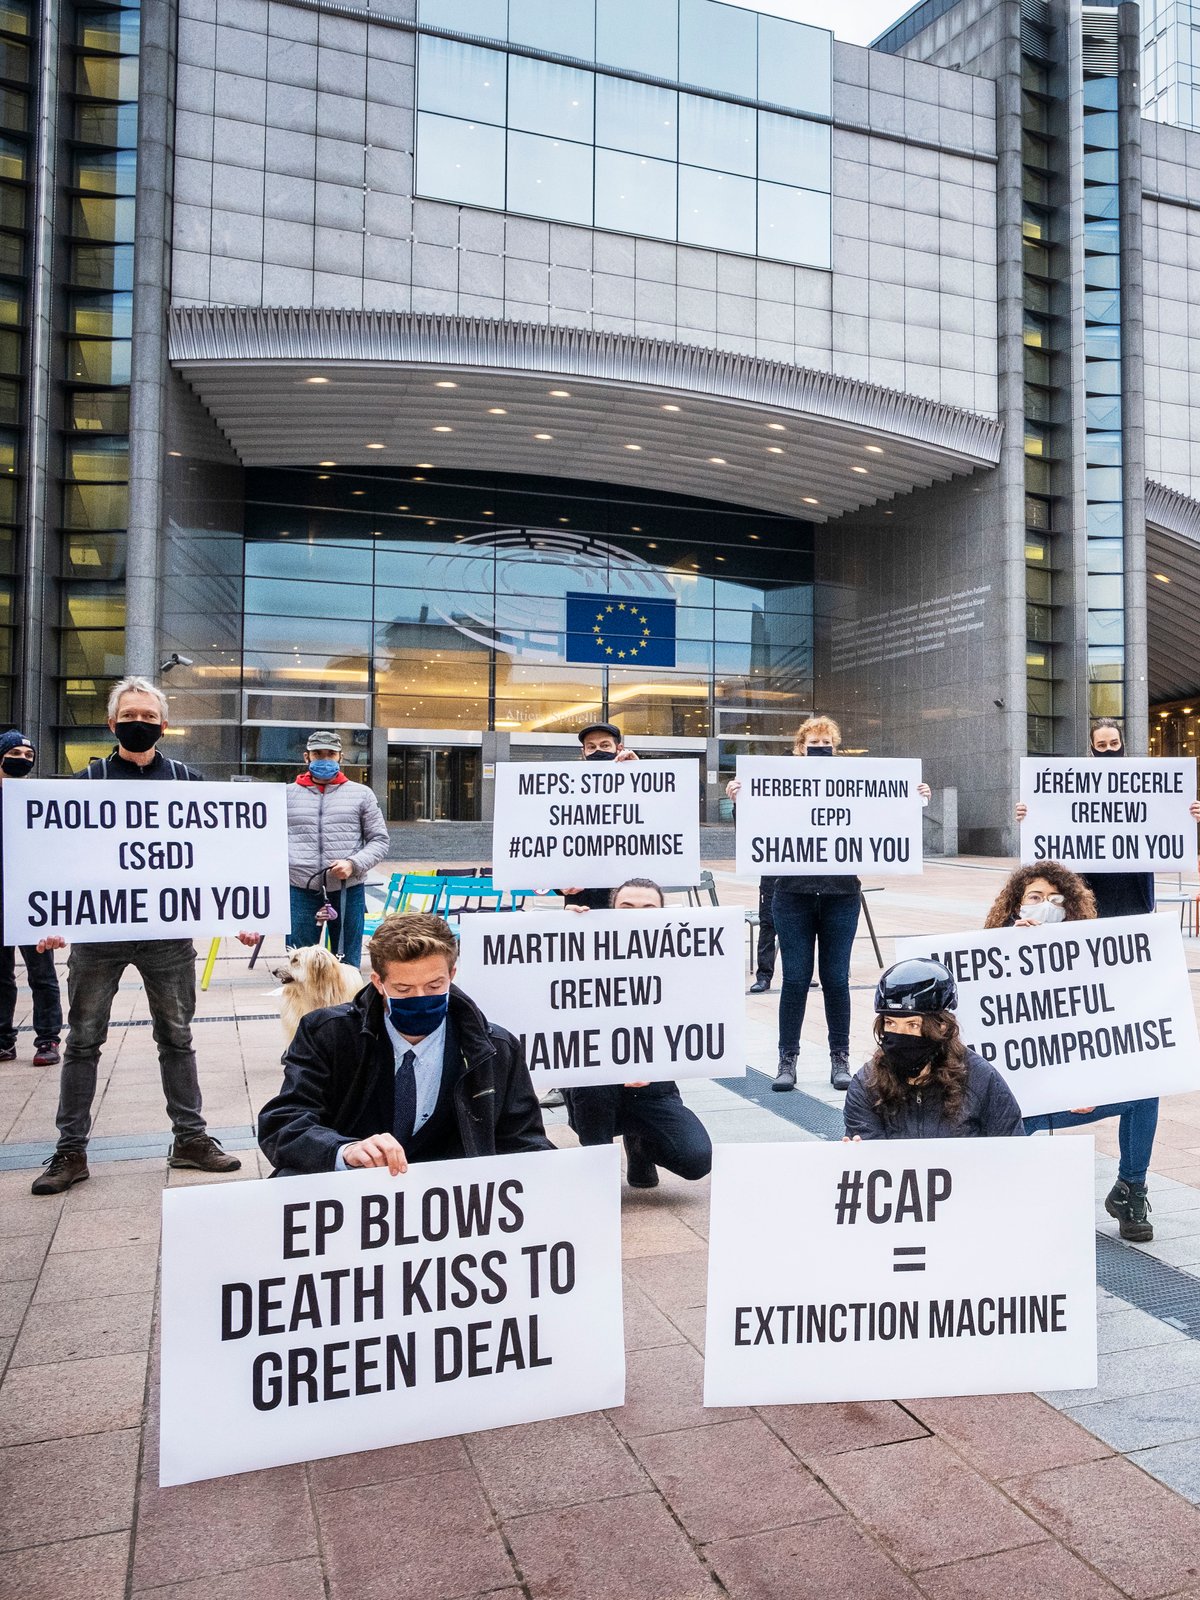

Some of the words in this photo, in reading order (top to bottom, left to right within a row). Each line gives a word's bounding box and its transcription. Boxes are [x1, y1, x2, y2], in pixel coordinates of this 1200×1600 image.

[518, 772, 575, 796] MEPS:
[580, 772, 625, 794] STOP
[629, 771, 676, 793] YOUR
[751, 778, 822, 797] HERBERT
[825, 778, 909, 798] DORFMANN
[1033, 767, 1103, 794] JÉRÉMY
[1107, 771, 1184, 794] DECERLE
[26, 799, 117, 830] PAOLO
[125, 800, 160, 829] DE
[167, 800, 267, 829] CASTRO
[549, 803, 645, 826] SHAMEFUL
[811, 807, 851, 826] (EPP)
[1071, 801, 1147, 823] (RENEW)
[118, 841, 194, 871] (S&D)
[508, 835, 558, 859] #CAP
[562, 833, 684, 858] COMPROMISE
[751, 836, 828, 863] SHAME
[834, 836, 863, 863] ON
[869, 836, 910, 863] YOU
[1034, 834, 1106, 860] SHAME
[1112, 834, 1139, 860] ON
[1144, 834, 1184, 860] YOU
[27, 888, 149, 928] SHAME
[159, 887, 201, 923] ON
[210, 885, 271, 921] YOU
[483, 931, 585, 966] MARTIN
[594, 921, 725, 961] HLAVÁČEK
[1018, 940, 1080, 976] STOP
[1085, 932, 1152, 968] YOUR
[550, 975, 662, 1010] (RENEW)
[979, 983, 1116, 1027] SHAMEFUL
[520, 1029, 601, 1071] AME
[611, 1026, 654, 1066] ON
[663, 1022, 725, 1062] YOU
[1004, 1017, 1176, 1071] COMPROMISE
[834, 1168, 952, 1225] #CAP
[282, 1199, 344, 1260] EP
[360, 1179, 525, 1251] BLOWS
[221, 1264, 384, 1342] DEATH
[402, 1249, 508, 1317] KISS
[521, 1240, 576, 1299] TO
[734, 1300, 919, 1346] EXTINCTION
[929, 1293, 1067, 1339] MACHINE
[252, 1331, 417, 1412] GREEN
[434, 1314, 553, 1384] DEAL
